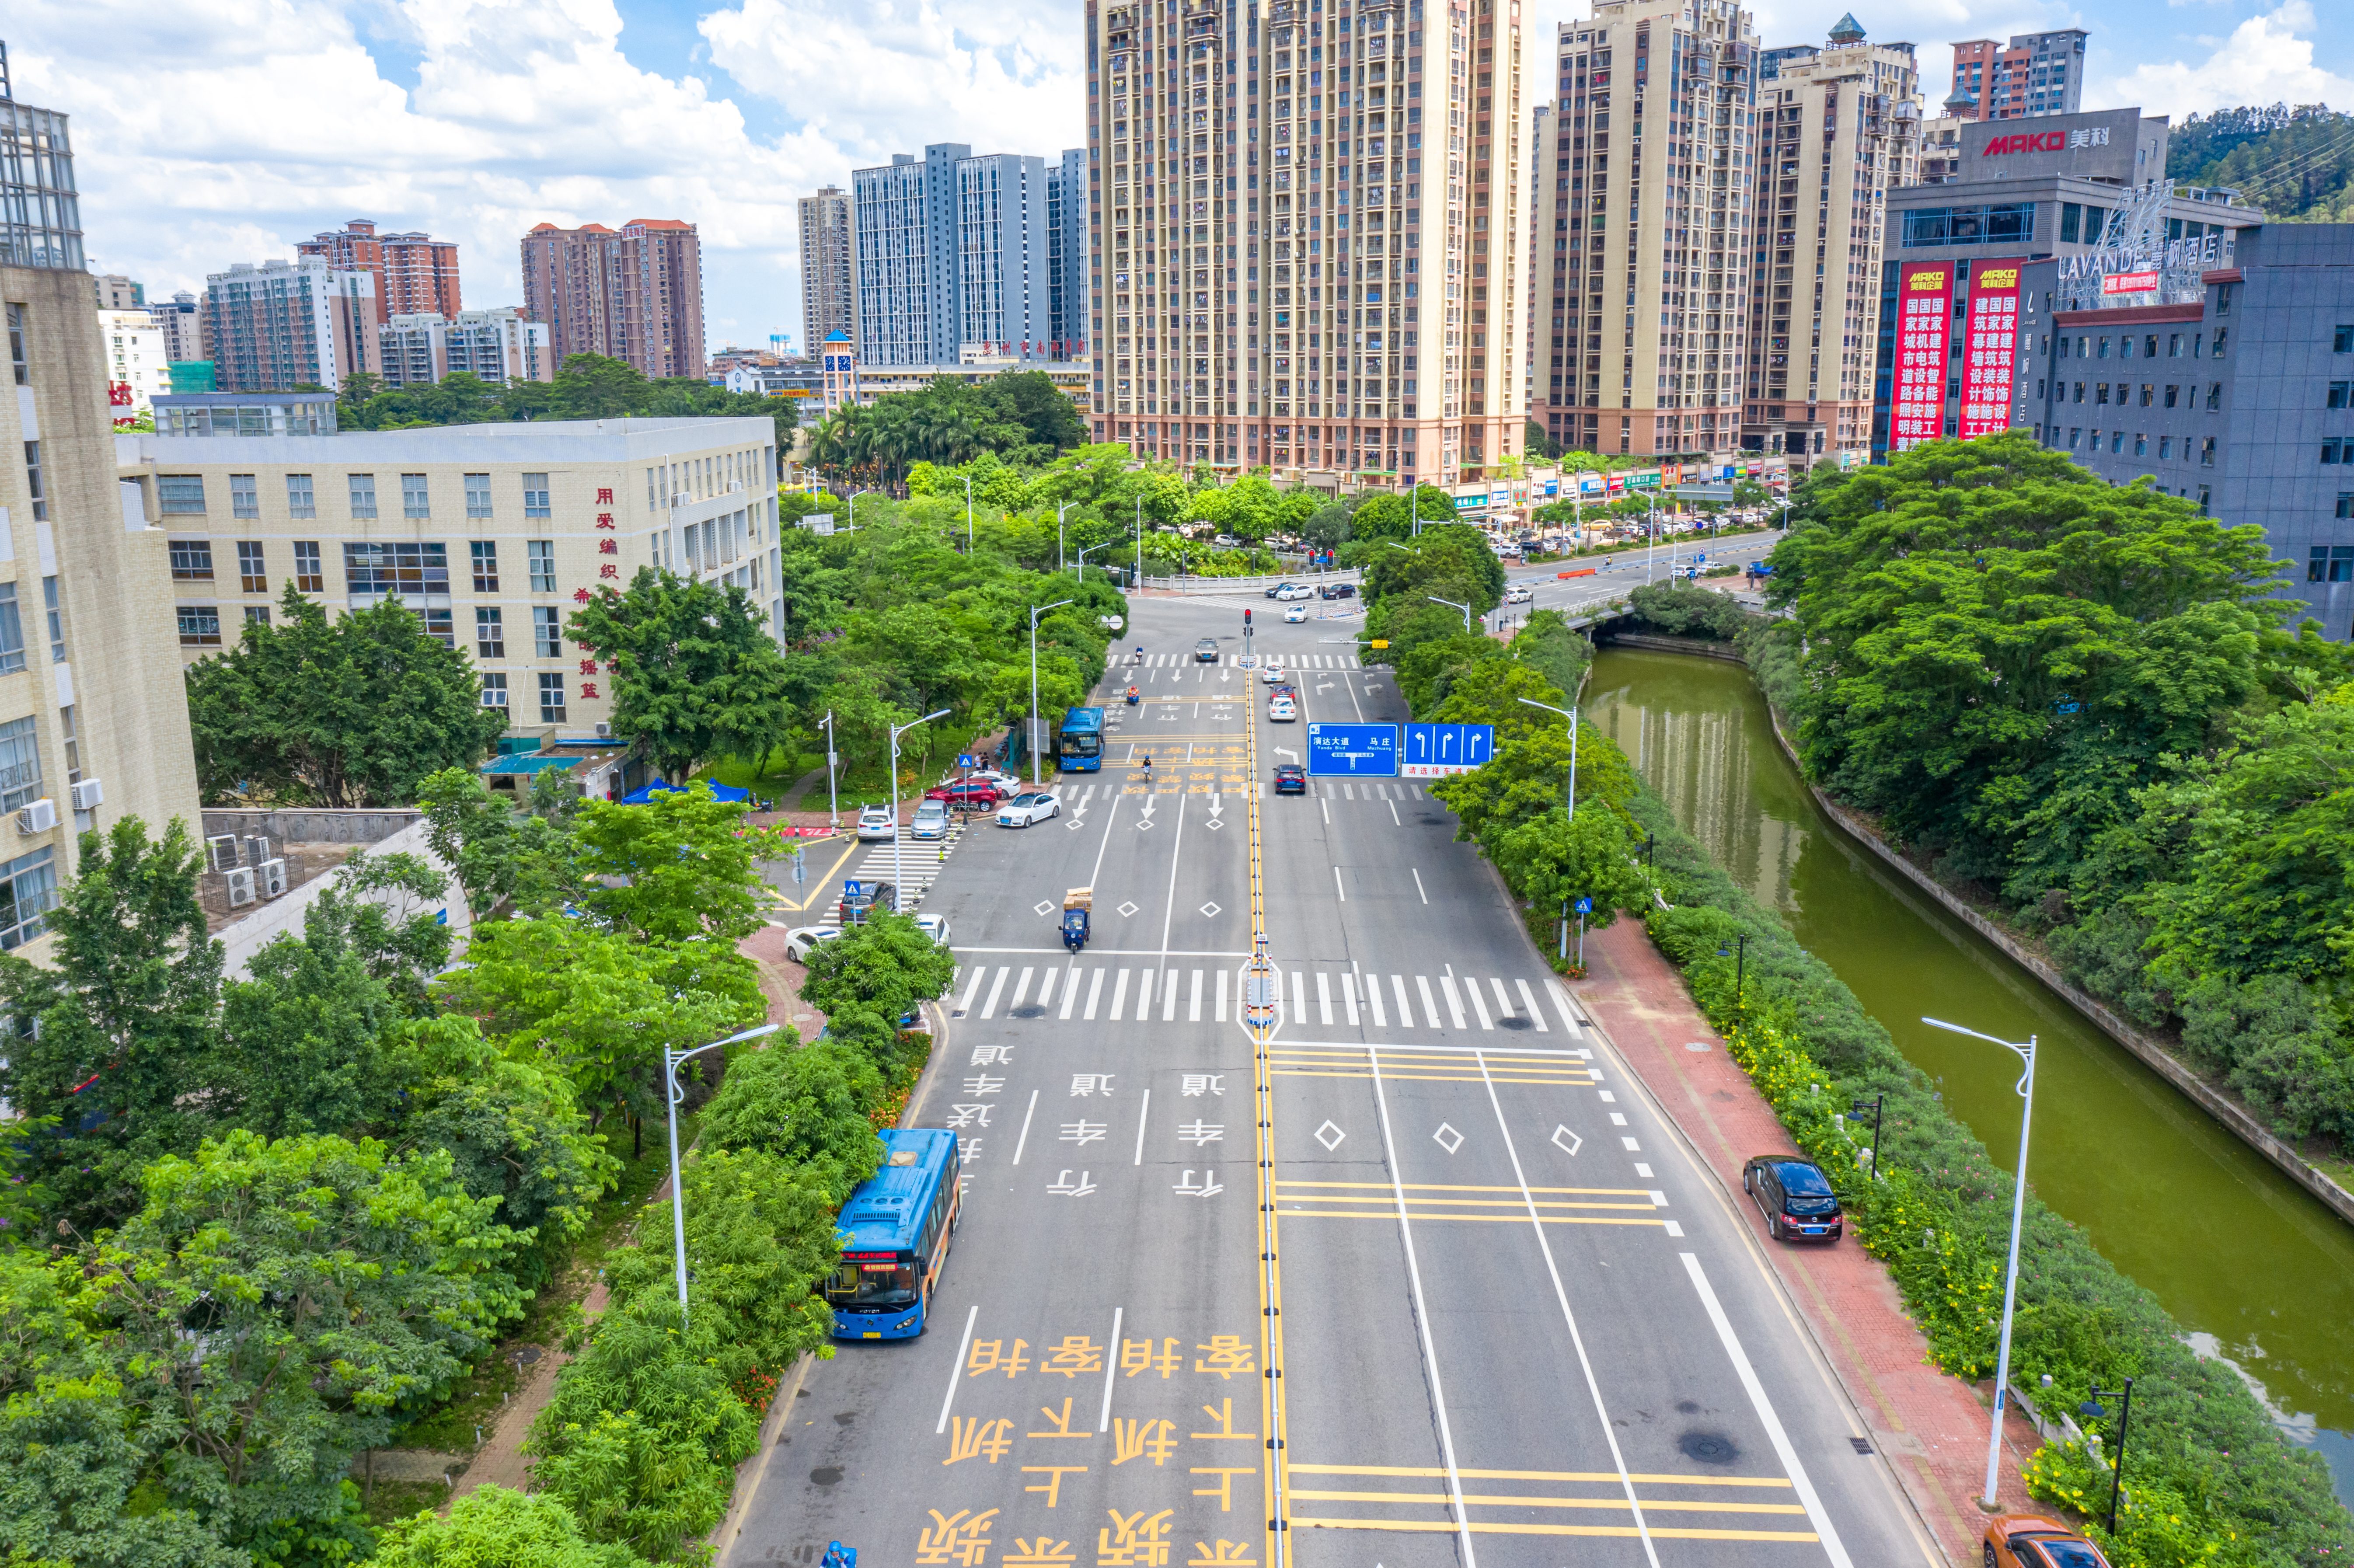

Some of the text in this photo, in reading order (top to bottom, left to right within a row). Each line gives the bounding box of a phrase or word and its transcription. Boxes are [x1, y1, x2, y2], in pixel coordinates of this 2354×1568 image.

[1983, 131, 2065, 156] MAKO
[2070, 127, 2110, 148] 美科
[1909, 272, 1944, 282] MAKO
[1979, 269, 2017, 280] MAKO
[2058, 244, 2145, 280] LAVANDE
[1922, 298, 1944, 441] 国家建筑智能施工
[1965, 297, 1988, 441] 建筑幕墙设计施工
[1978, 297, 2002, 436] 国家建筑装饰施工
[1992, 297, 2016, 434] 国家建筑装饰设计
[1514, 491, 1527, 501] 诊所
[573, 587, 600, 699] 希摇篮
[1157, 695, 1182, 721] 行车道
[1210, 694, 1233, 721] 行车道
[1313, 737, 1390, 746] 演达大道 马庄
[1187, 746, 1217, 794] 视频抓拍
[1409, 766, 1481, 774] 请选择车道
[1046, 1073, 1116, 1197] 行车道
[1172, 1073, 1226, 1198] 行车道
